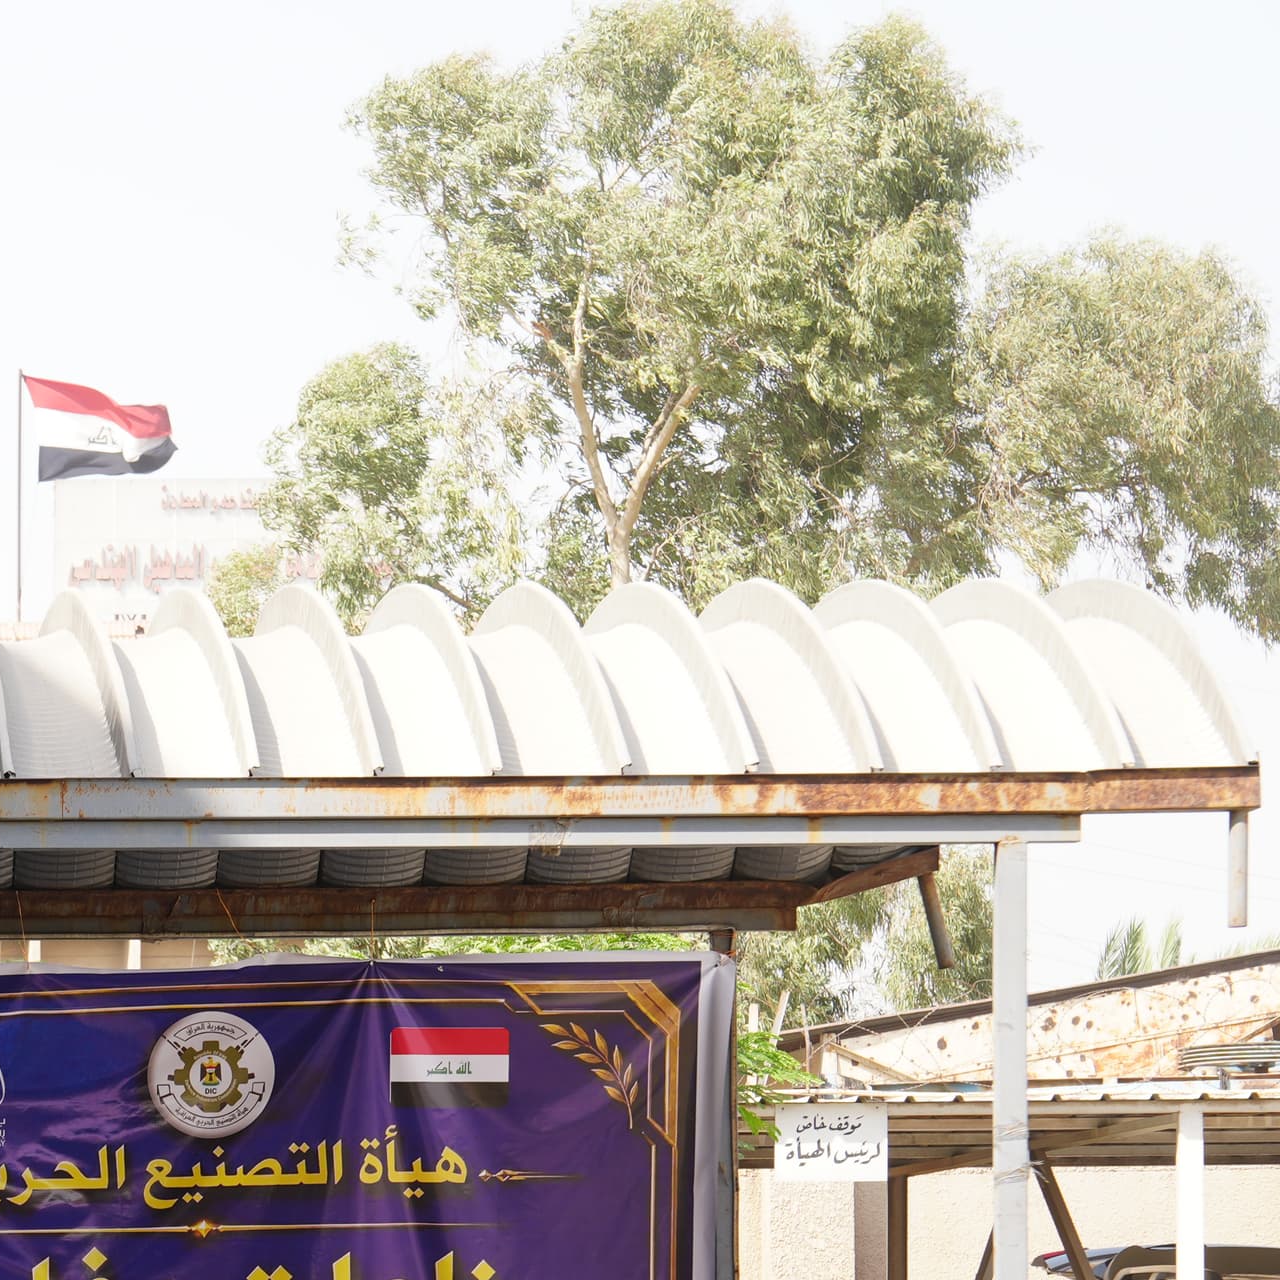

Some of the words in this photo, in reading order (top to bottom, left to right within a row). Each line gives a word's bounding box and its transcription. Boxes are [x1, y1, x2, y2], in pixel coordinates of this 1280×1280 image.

[204, 1087, 217, 1095] DIC
[143, 1139, 344, 1209] التصنيع
[358, 1125, 468, 1198] هيأة
[834, 1141, 881, 1165] لرئيس
